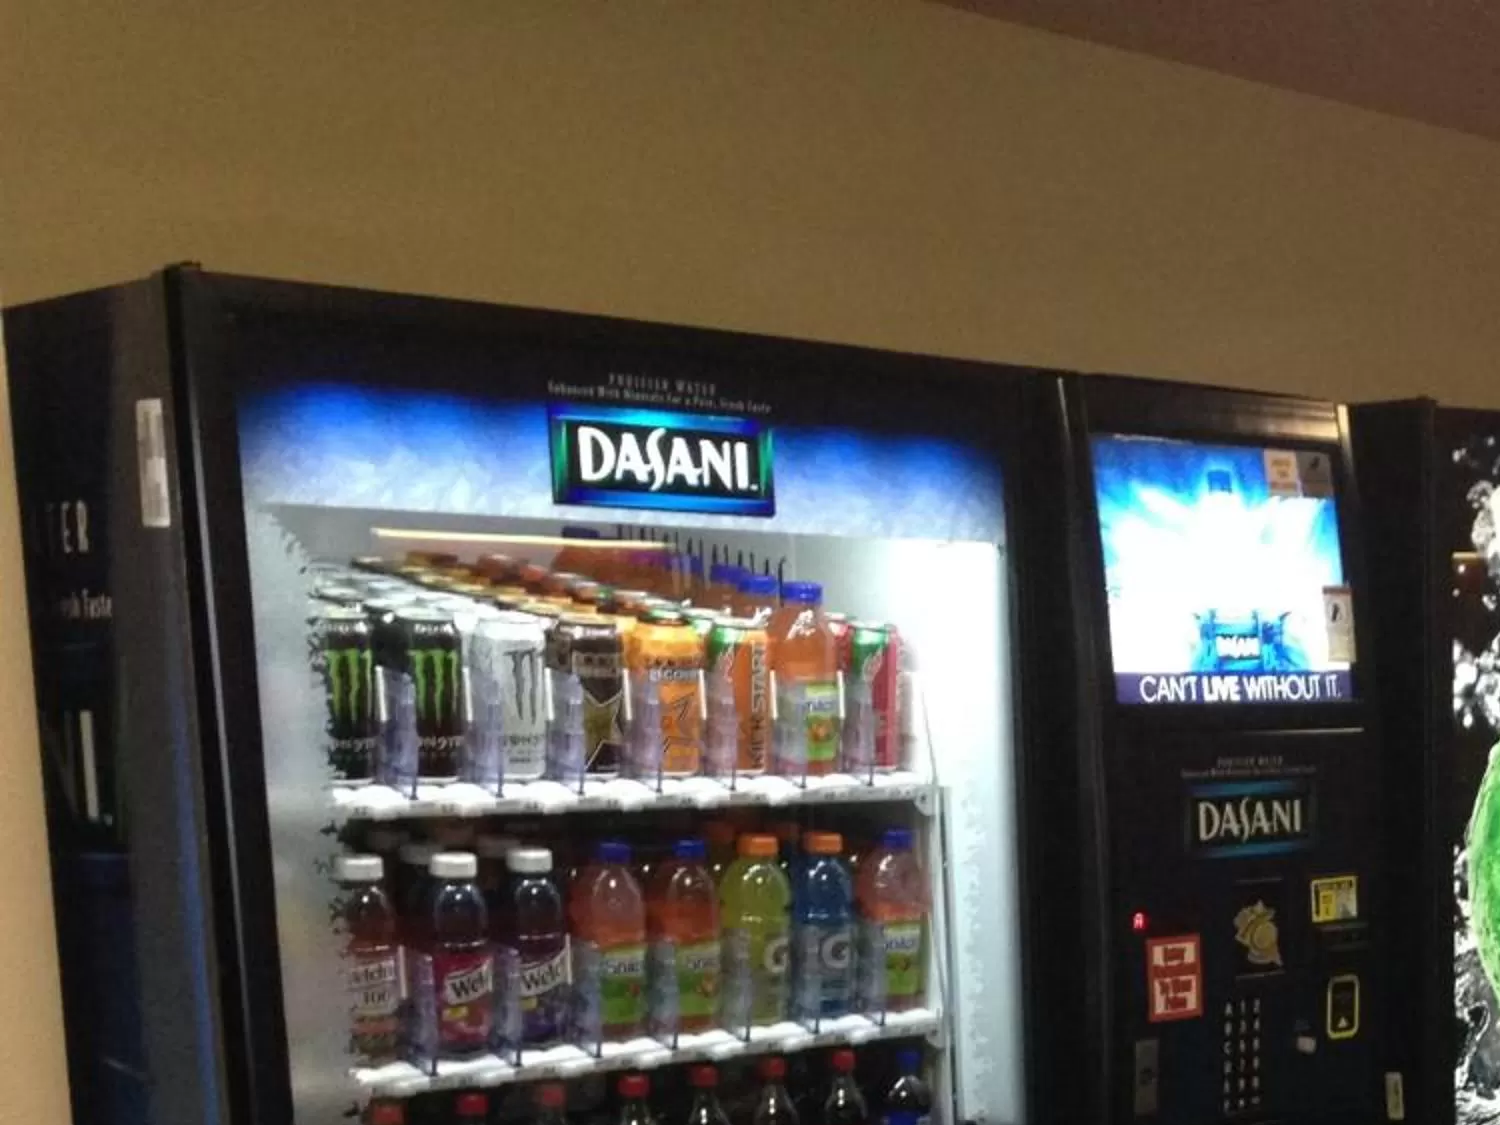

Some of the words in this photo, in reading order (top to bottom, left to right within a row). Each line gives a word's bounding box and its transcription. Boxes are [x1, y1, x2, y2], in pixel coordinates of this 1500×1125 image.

[577, 425, 752, 492] DASANI
[1139, 675, 1197, 703] CAN'T
[1202, 675, 1243, 702] LIVE
[1245, 674, 1322, 702] WITHOUT
[1197, 796, 1303, 843] DASANI
